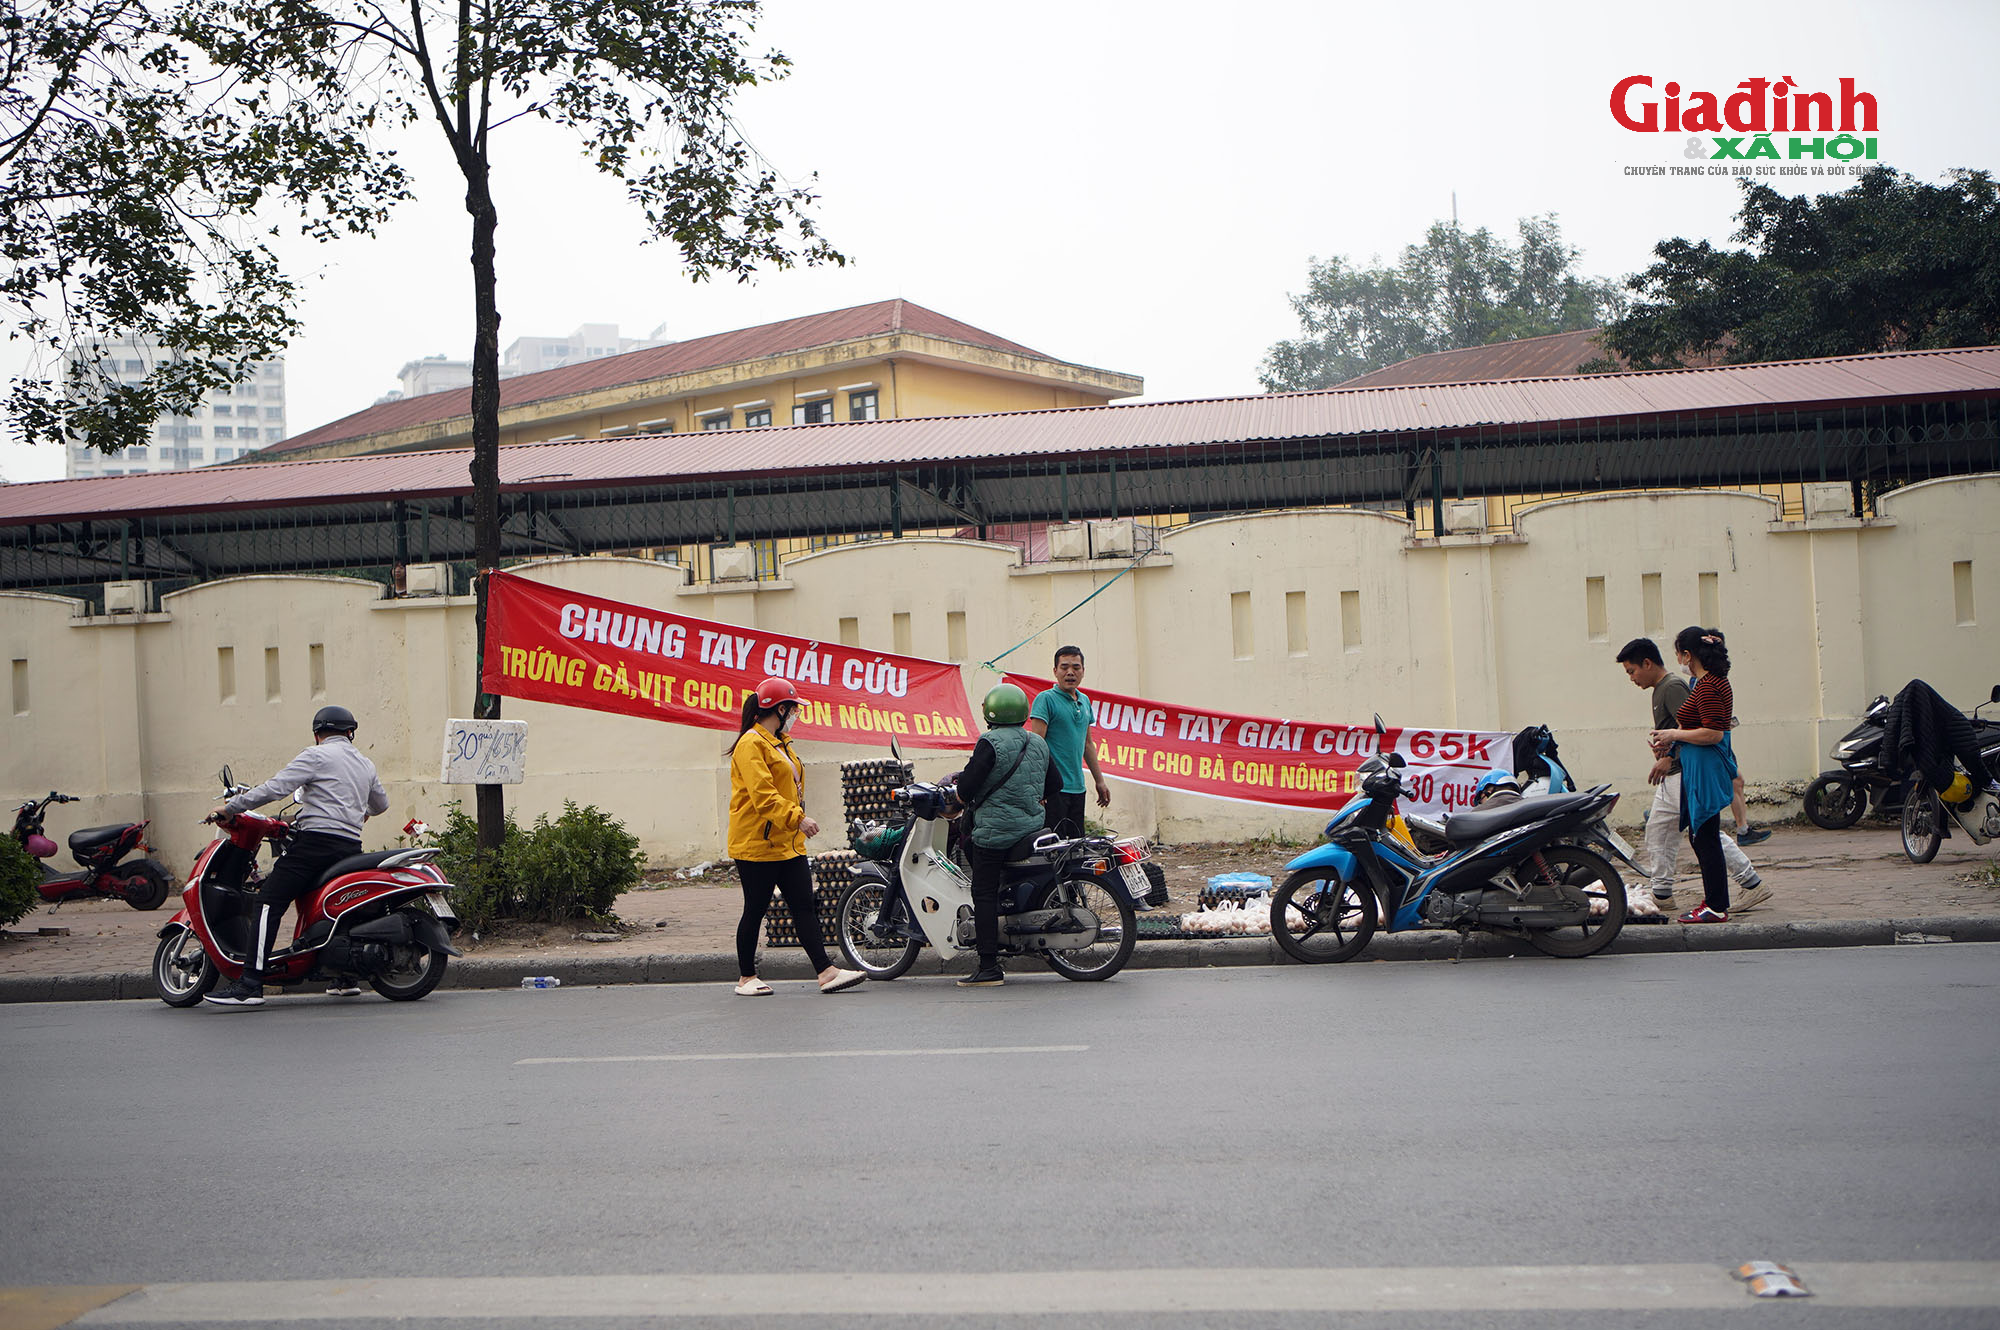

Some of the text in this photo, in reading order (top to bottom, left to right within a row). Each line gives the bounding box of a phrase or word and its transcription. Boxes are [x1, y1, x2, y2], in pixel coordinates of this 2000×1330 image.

[559, 603, 909, 699] CHUNG TAY GIẢI CỨU
[500, 645, 587, 688] TRỨNG
[683, 679, 733, 713] CHO
[798, 698, 833, 728] ON
[839, 702, 910, 735] NÔNG
[913, 711, 968, 738] DÂN
[1177, 713, 1232, 744] TAY
[1237, 718, 1306, 752] GIẢI
[1312, 726, 1379, 758] CỨU
[1093, 738, 1147, 771] À,VỊT
[1152, 750, 1193, 777] CHO
[1198, 754, 1226, 781] BÀ
[1232, 760, 1275, 787] CON
[1280, 762, 1338, 793] NÔNG
[1409, 774, 1434, 804] 30
